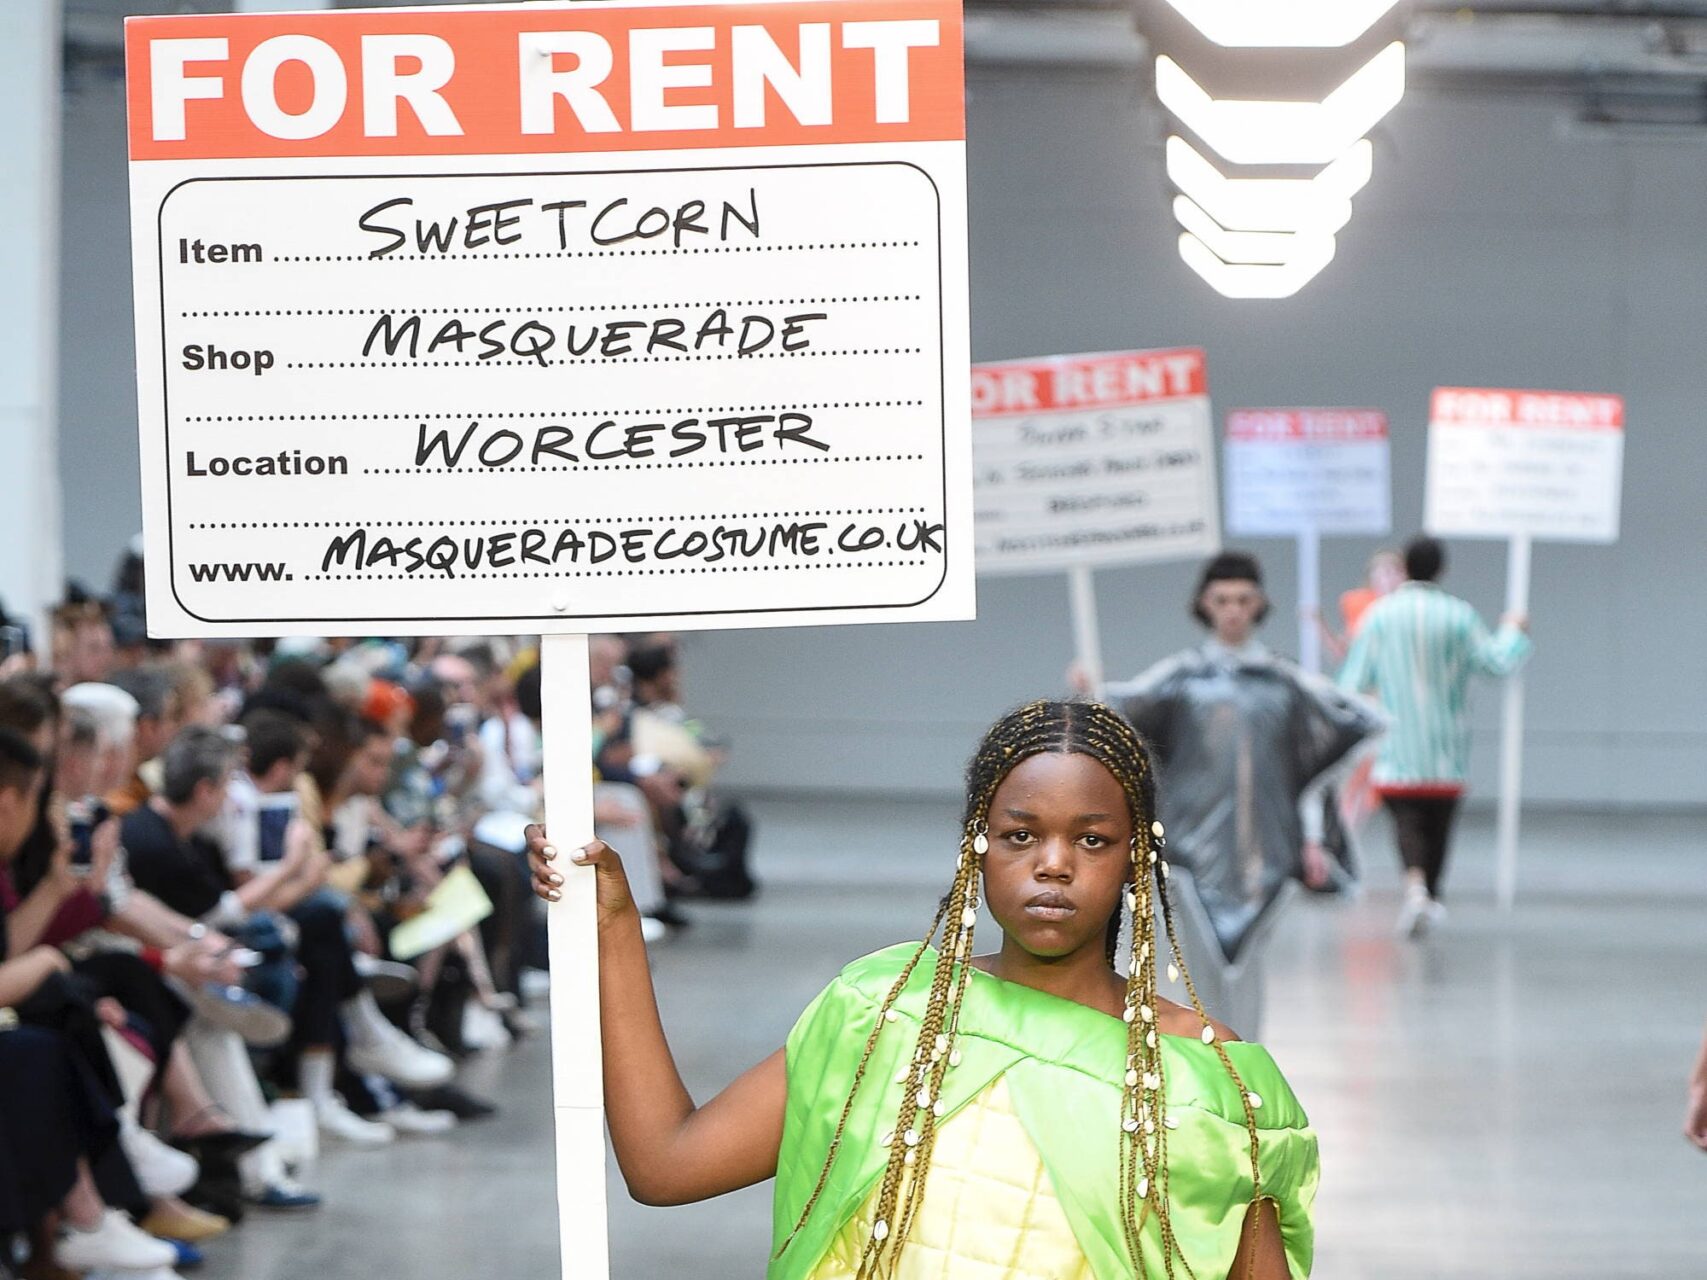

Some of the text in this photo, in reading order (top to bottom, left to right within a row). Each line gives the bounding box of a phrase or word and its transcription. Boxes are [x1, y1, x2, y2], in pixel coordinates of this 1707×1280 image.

[149, 20, 940, 141] FOR RENT
[179, 188, 759, 264] Item SWEETCORN
[182, 309, 828, 376] Shop MASQUERADE
[971, 355, 1195, 410] OR RENT
[1436, 391, 1615, 426] FOR RENT
[186, 413, 831, 477] Location WORCESTER
[188, 519, 944, 582] www. MASQUERADECOSTUME.CO.UK
